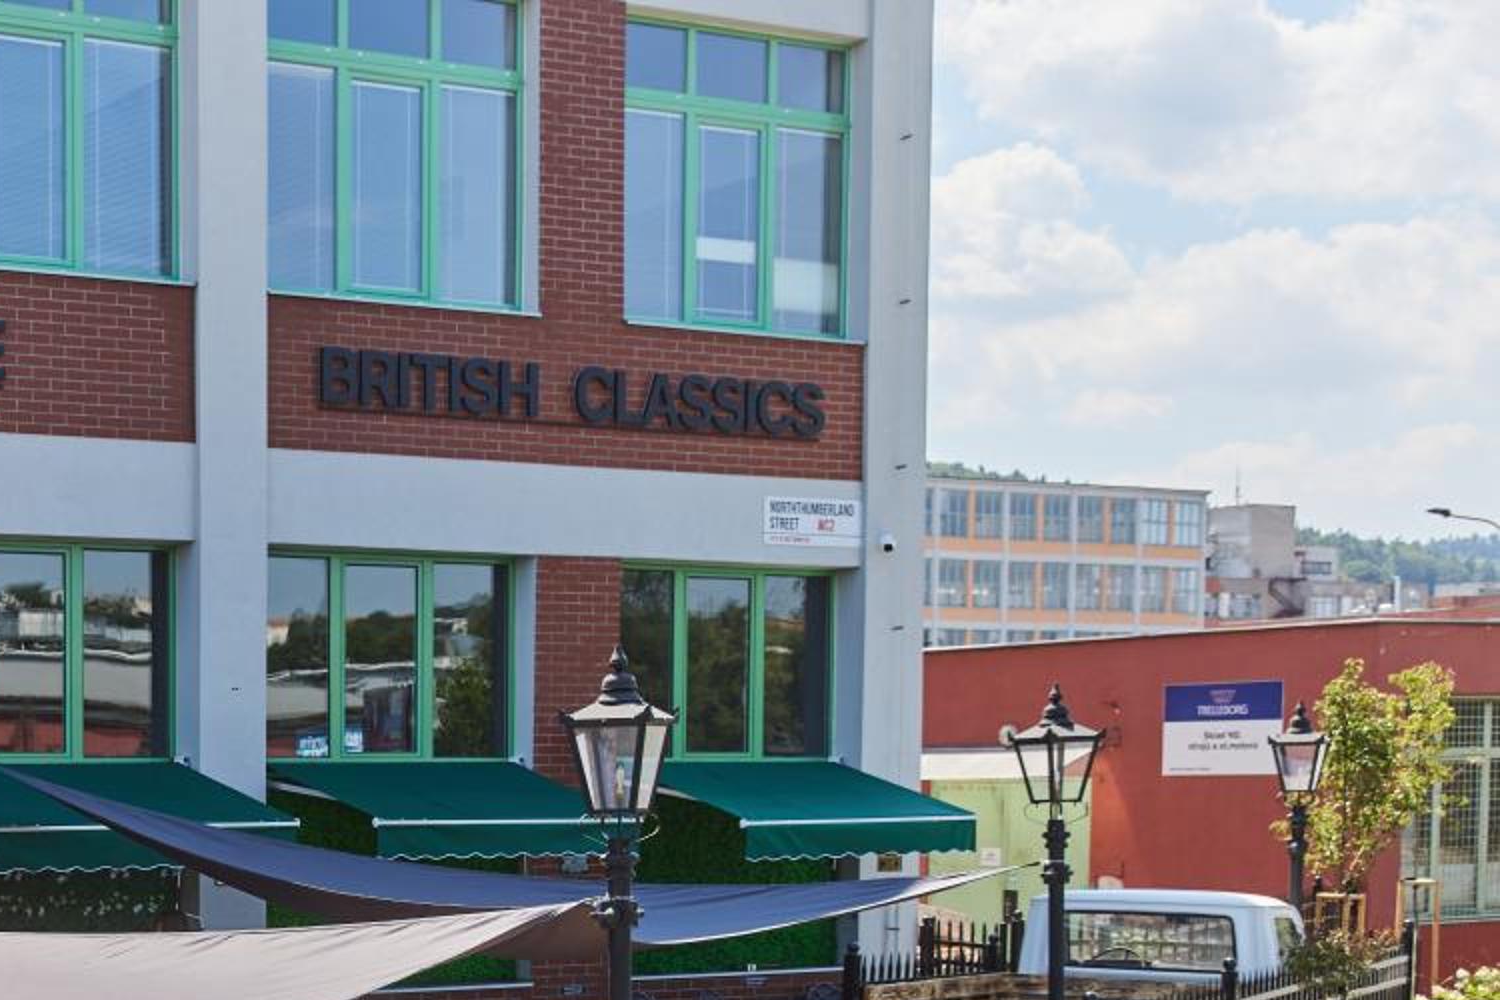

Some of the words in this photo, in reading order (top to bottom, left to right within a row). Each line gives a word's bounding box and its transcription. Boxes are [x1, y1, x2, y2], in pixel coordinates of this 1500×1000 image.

[319, 346, 540, 417] BRITISH
[574, 366, 826, 438] CLASSICS
[770, 517, 799, 530] STREET
